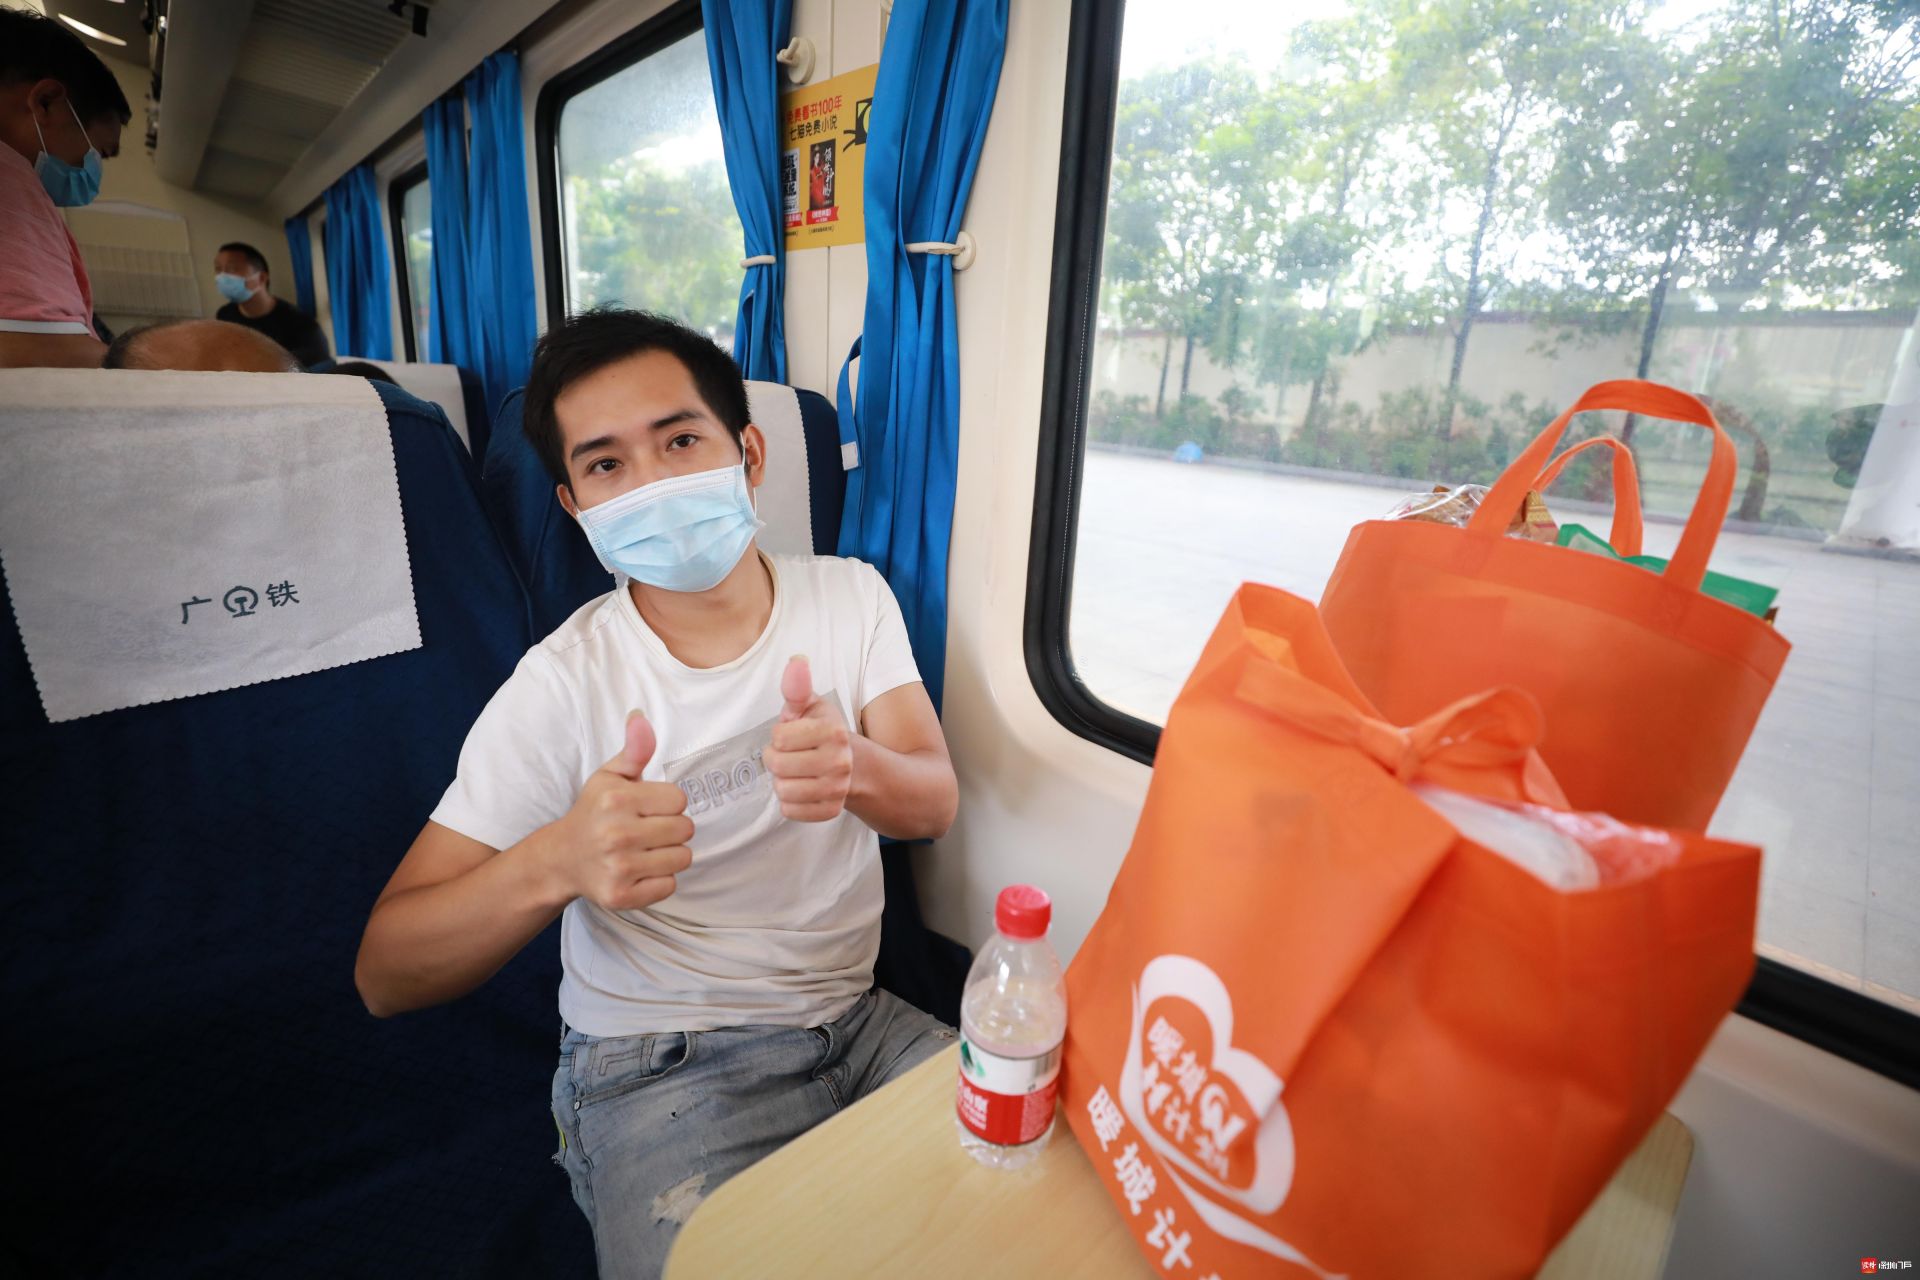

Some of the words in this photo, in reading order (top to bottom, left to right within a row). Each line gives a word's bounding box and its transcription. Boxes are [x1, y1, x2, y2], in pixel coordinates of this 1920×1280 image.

[790, 115, 837, 141] 七猫免费小说
[1086, 1083, 1224, 1280] 暖城计
